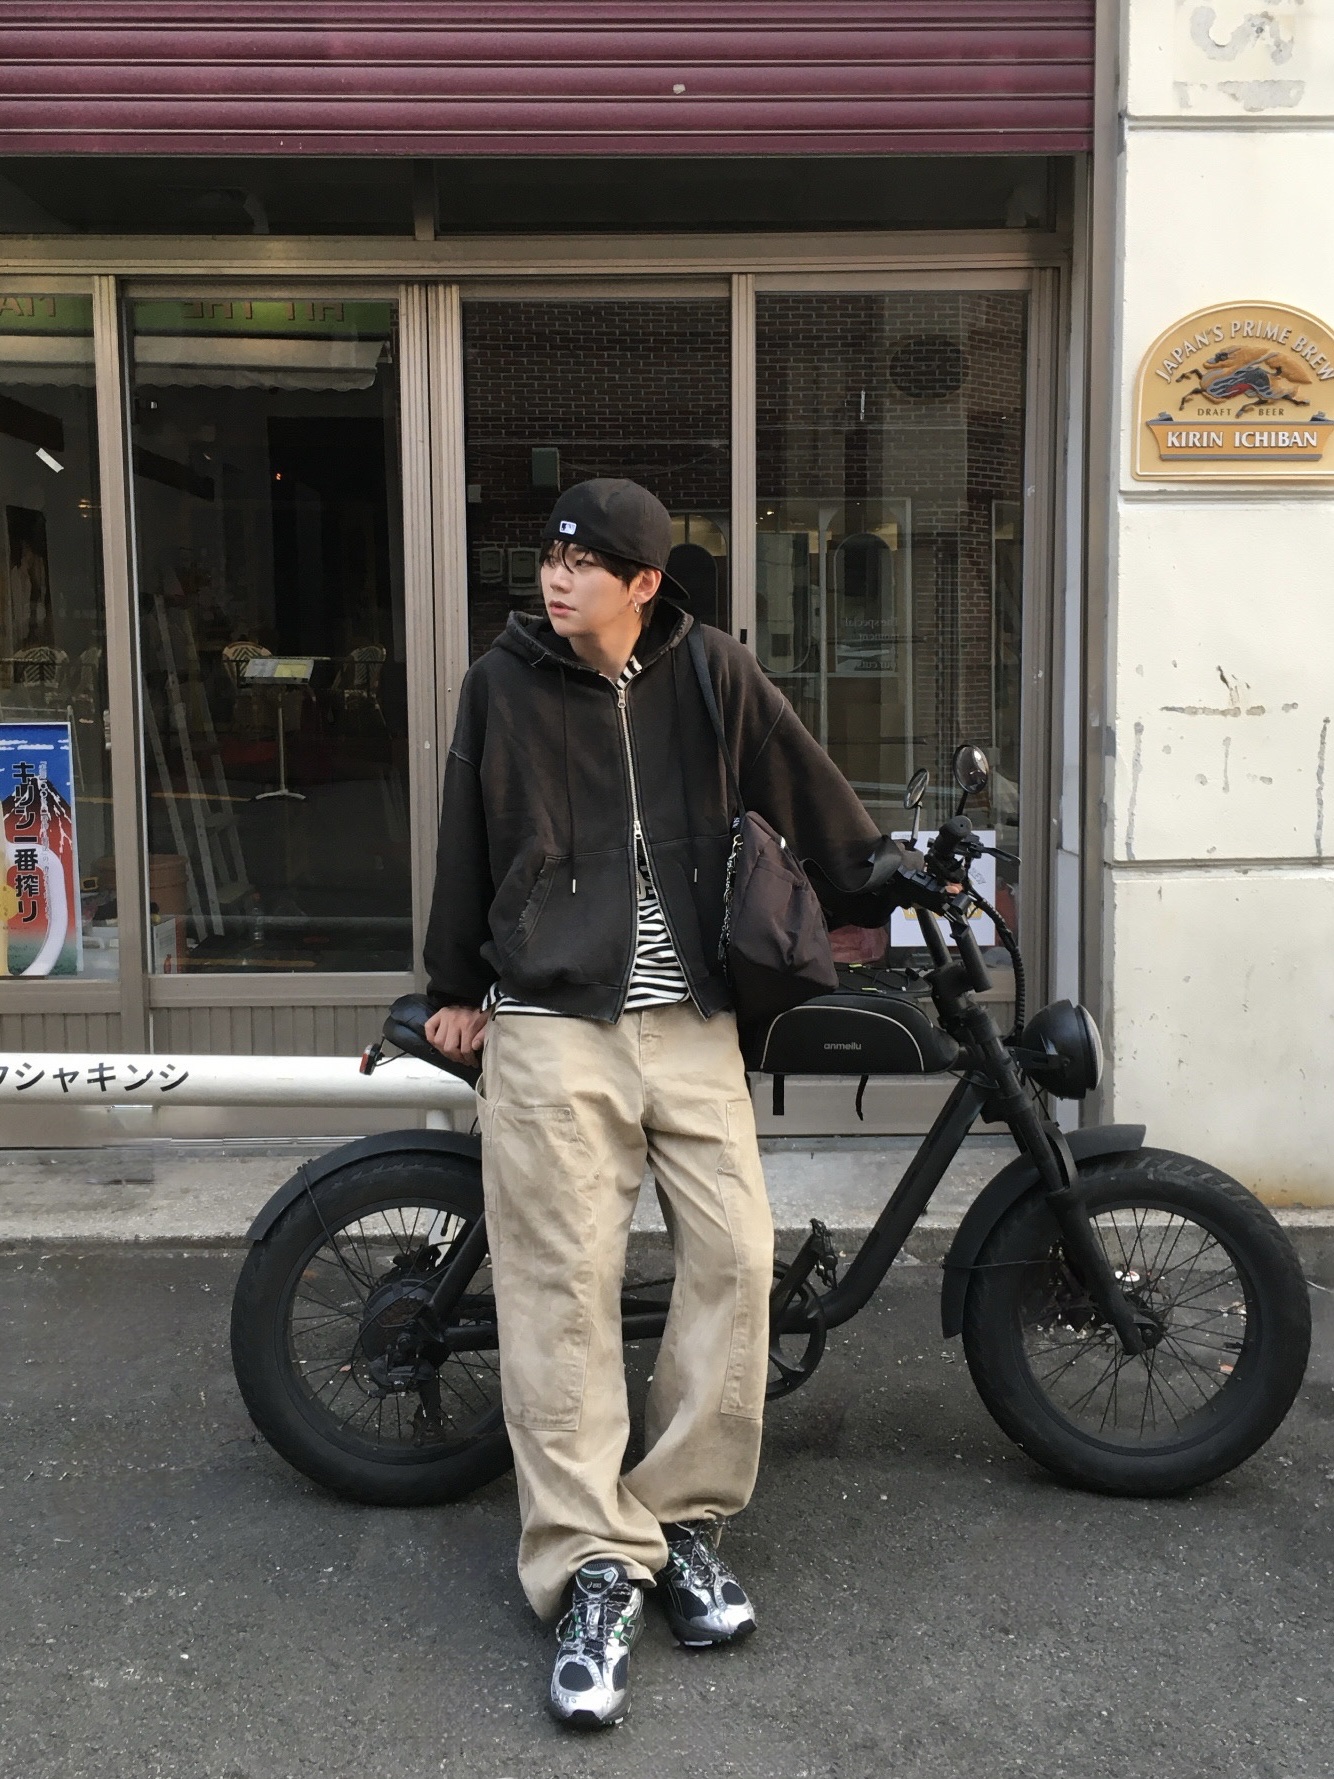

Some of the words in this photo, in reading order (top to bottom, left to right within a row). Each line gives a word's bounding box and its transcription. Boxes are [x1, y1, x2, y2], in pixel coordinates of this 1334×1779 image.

[1155, 323, 1225, 384] JAPAN'S
[1230, 319, 1293, 346] PRIME
[1197, 408, 1232, 416] DRAFT
[1258, 408, 1285, 416] BEER
[1166, 431, 1224, 449] KIRIN
[1234, 431, 1318, 449] ICHIBAN
[12, 761, 39, 923] キリン一番搾り
